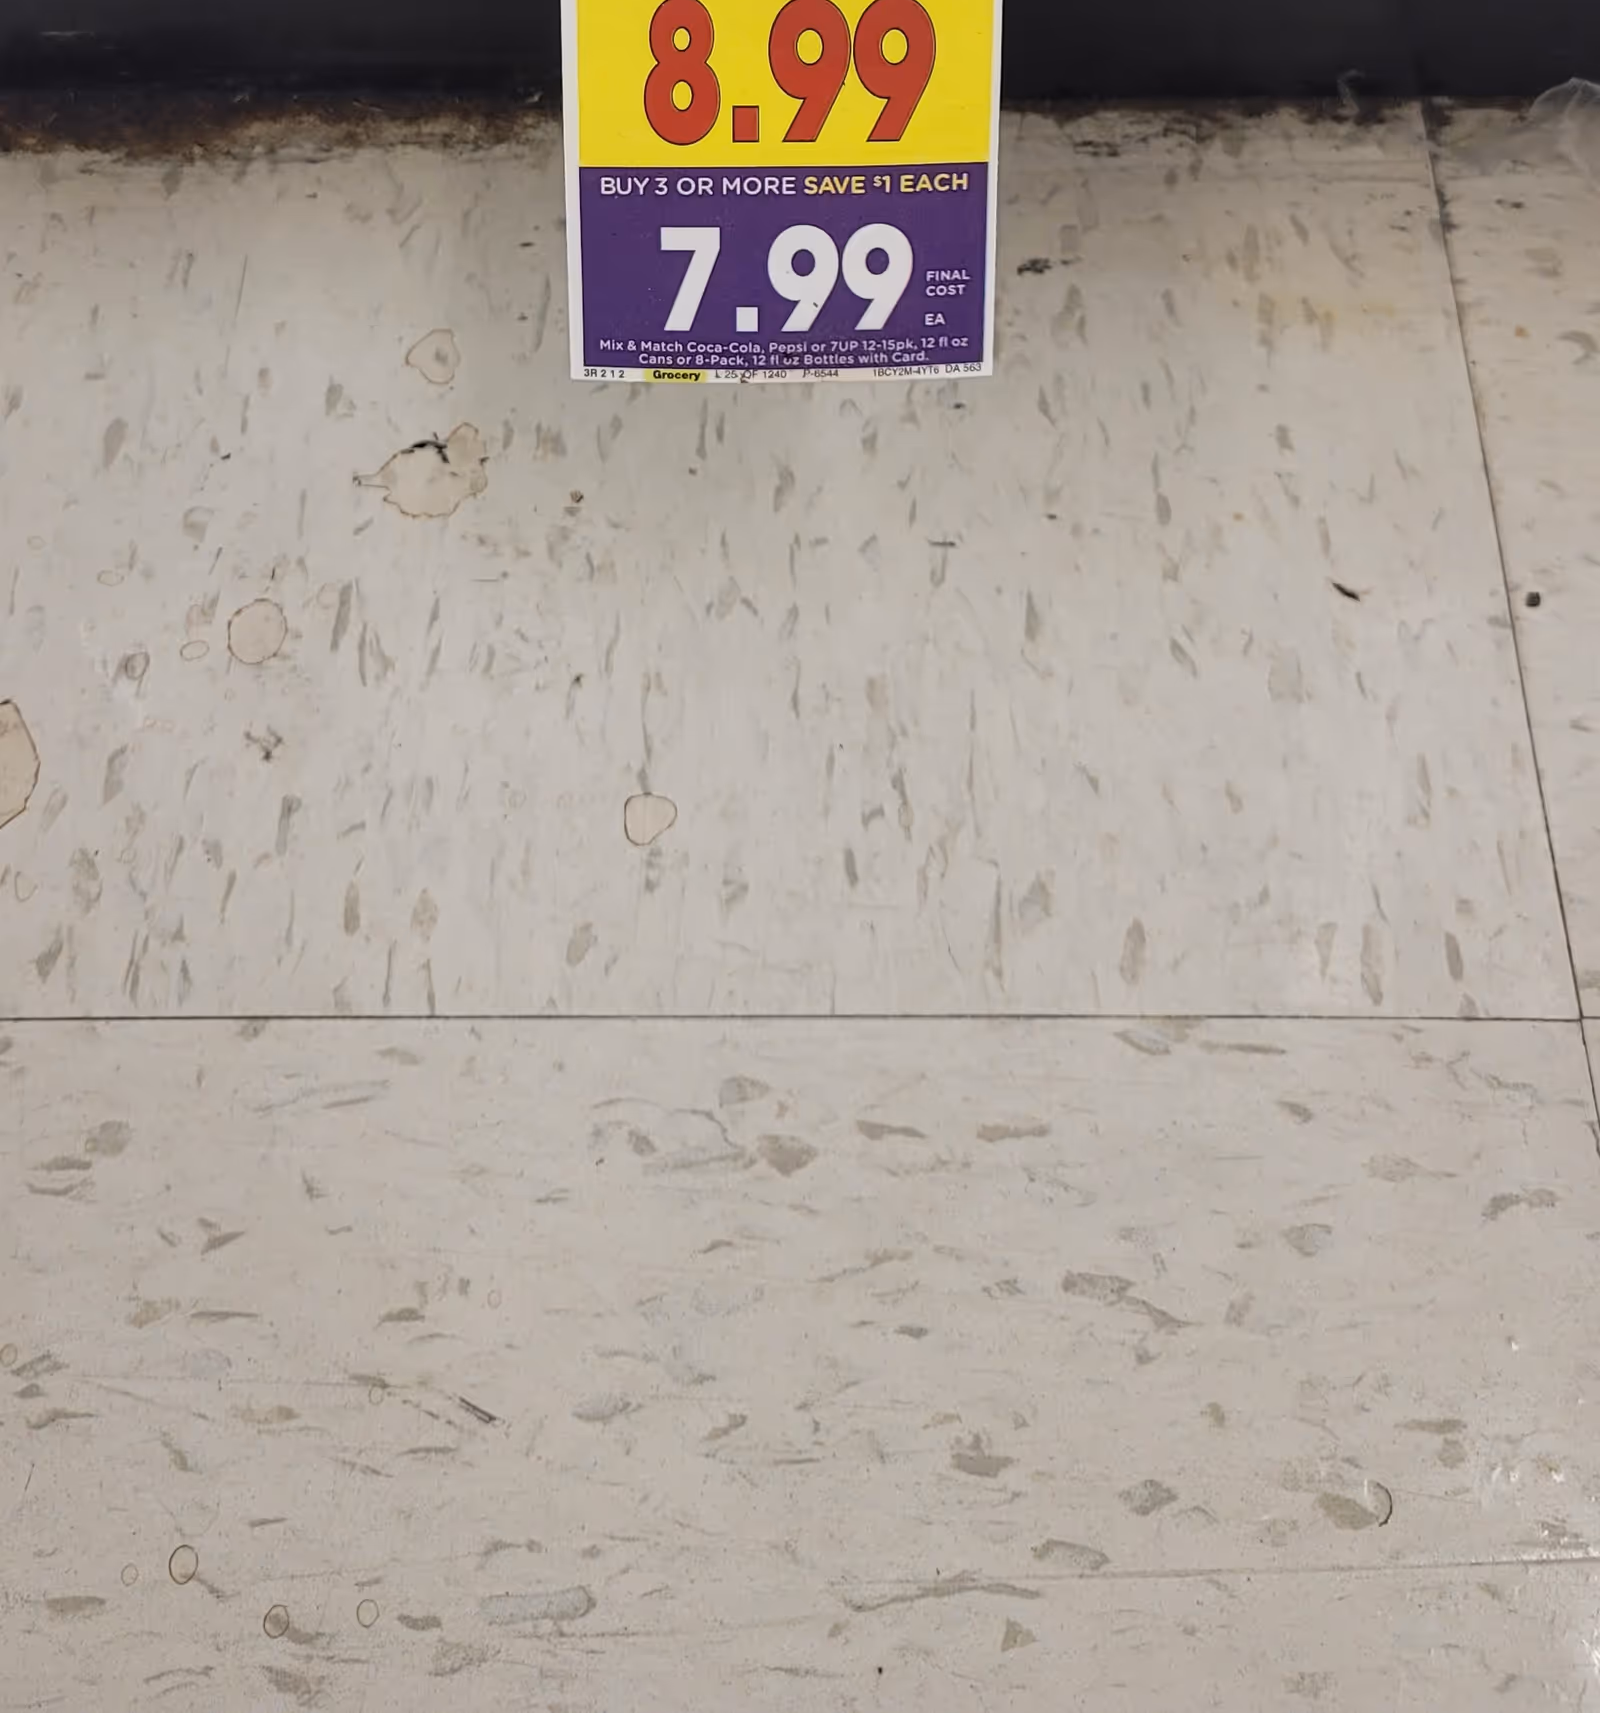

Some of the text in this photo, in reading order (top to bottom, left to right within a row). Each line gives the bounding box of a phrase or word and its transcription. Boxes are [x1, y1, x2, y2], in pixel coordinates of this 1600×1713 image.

[600, 172, 969, 195] BUY 3 OR MORE SAVE $1 EACH
[660, 222, 914, 333] 7.99
[926, 269, 970, 282] FINAL
[926, 284, 966, 296] COST
[925, 313, 946, 326] EA
[600, 336, 969, 355] Mix & Match Coca-Cola, Pepsi or 7UP 12-15pk, 12 fl oz
[638, 353, 674, 365] Cans
[676, 355, 691, 365] or
[695, 354, 749, 367] 8-Pack,
[753, 354, 767, 365] 12
[770, 354, 780, 365] fl
[804, 353, 854, 365] Bottles
[857, 352, 889, 364] with
[892, 351, 930, 363] Card.
[583, 368, 598, 378] 3R
[653, 369, 701, 381] Grocery
[762, 369, 787, 379] 1240
[945, 364, 961, 374] DA
[963, 363, 982, 373] 563
